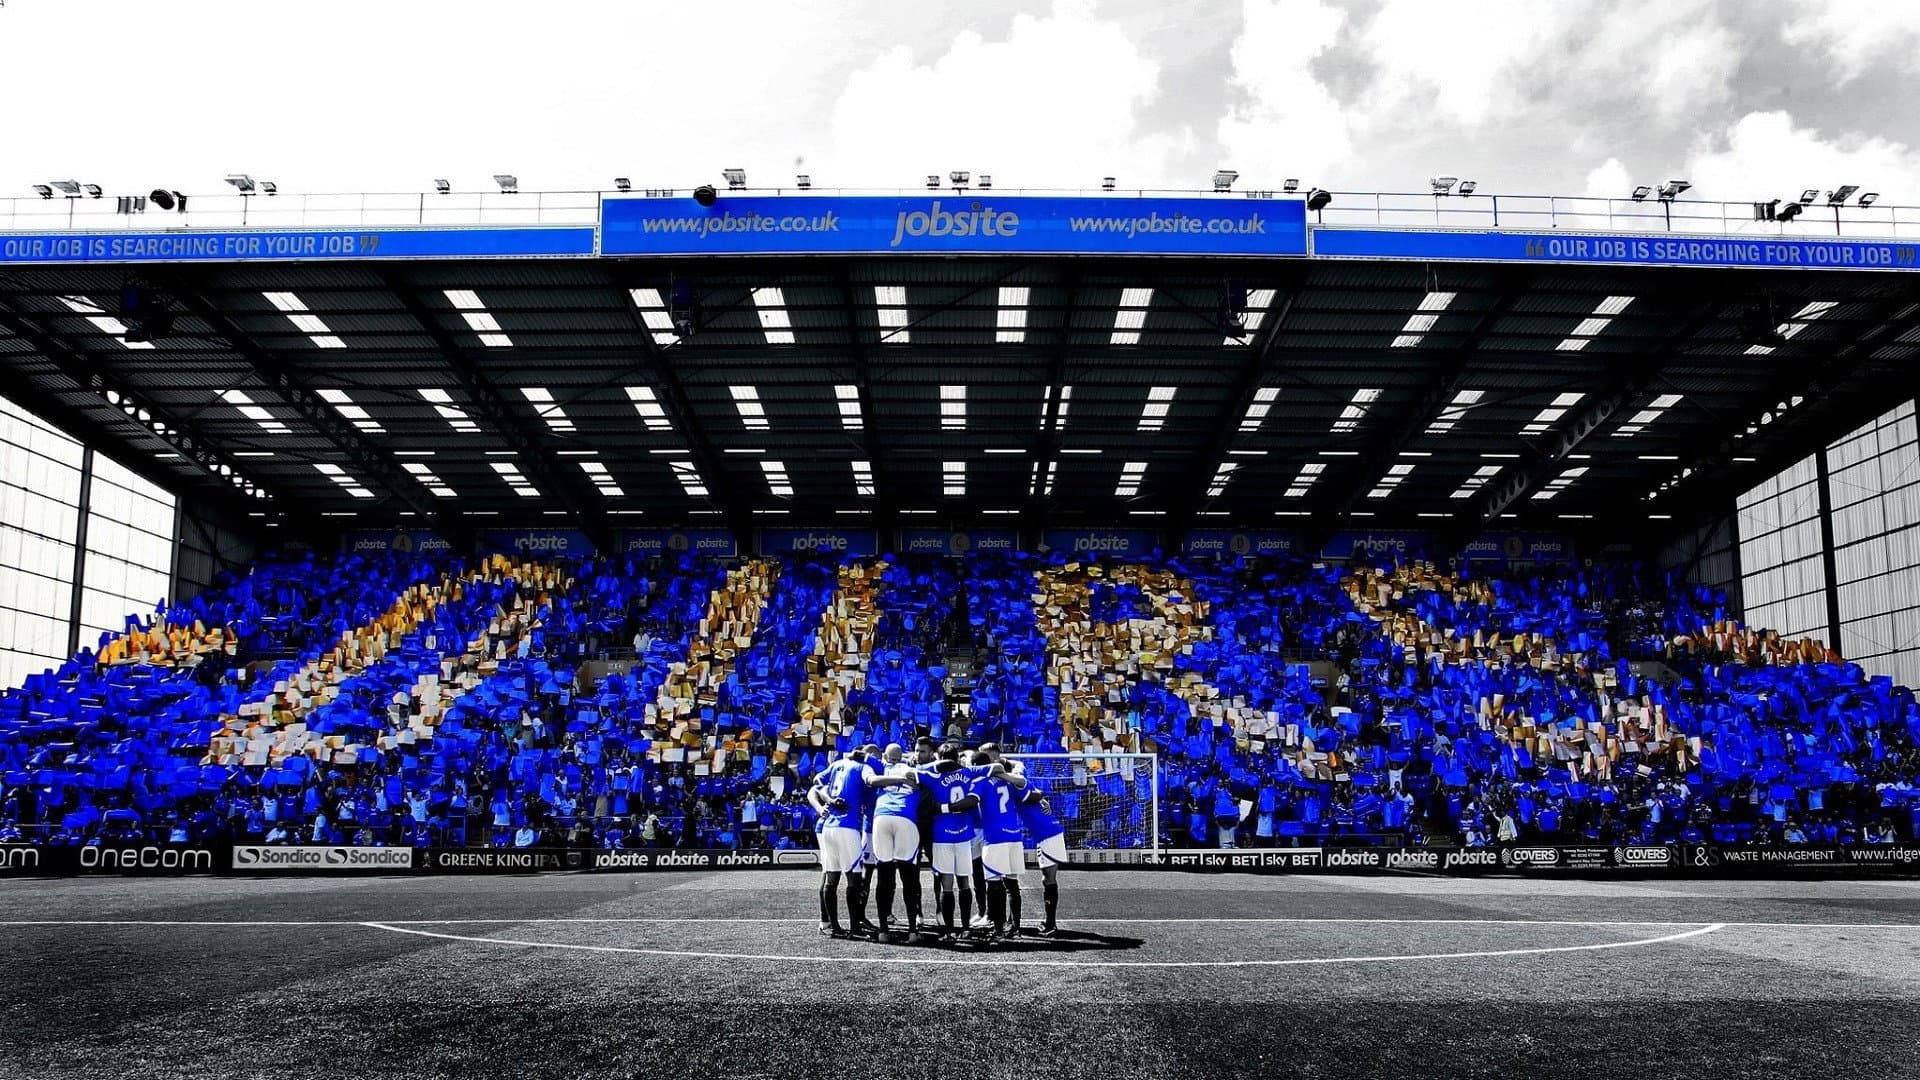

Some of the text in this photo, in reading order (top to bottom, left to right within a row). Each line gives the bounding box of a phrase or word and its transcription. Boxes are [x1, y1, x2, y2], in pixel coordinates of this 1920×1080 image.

[642, 210, 840, 239] www.jobsite.co.uk
[890, 200, 1020, 247] jobsite
[1069, 212, 1267, 240] www.jobsite.co.uk
[5, 239, 43, 257] OUR
[48, 239, 83, 257] JOB
[88, 239, 106, 256] IS
[110, 237, 219, 256] SEARCHING
[224, 237, 260, 255] FOR
[265, 236, 316, 254] YOUR
[319, 236, 355, 253] JOB
[1548, 239, 1589, 257] OUR
[1592, 240, 1627, 258] JOB
[1631, 241, 1650, 259] IS
[1653, 242, 1761, 261] SEARCHING
[1765, 244, 1802, 262] FOR
[1804, 245, 1855, 263] YOUR
[1858, 246, 1893, 264] JOB
[354, 538, 388, 553] jobsite
[628, 537, 662, 551] jobsite
[695, 537, 729, 551] jobsite
[792, 532, 848, 551] jobsite
[908, 537, 943, 552] jobsite
[977, 537, 1012, 552] jobsite
[1073, 532, 1129, 553] jobsite
[1190, 537, 1224, 552] jobsite
[1256, 537, 1290, 552] jobsite
[1464, 539, 1497, 554] jobsite
[996, 784, 1010, 814] 7
[80, 847, 212, 868] OneCom
[261, 849, 410, 865] Sondico Sondico
[438, 852, 561, 867] GREENE KING IPA
[595, 849, 648, 867] jobsite
[655, 850, 709, 866] jobsite
[1205, 853, 1258, 866] sky BET
[1265, 853, 1319, 867] sky BET
[1326, 848, 1497, 869] jobsite jobsite jobsite
[1513, 849, 1556, 861] COVERS
[1625, 848, 1667, 860] COVERS
[1723, 850, 1836, 861] WASTE MANAGEMENT
[1850, 847, 1920, 863] www.ridge
